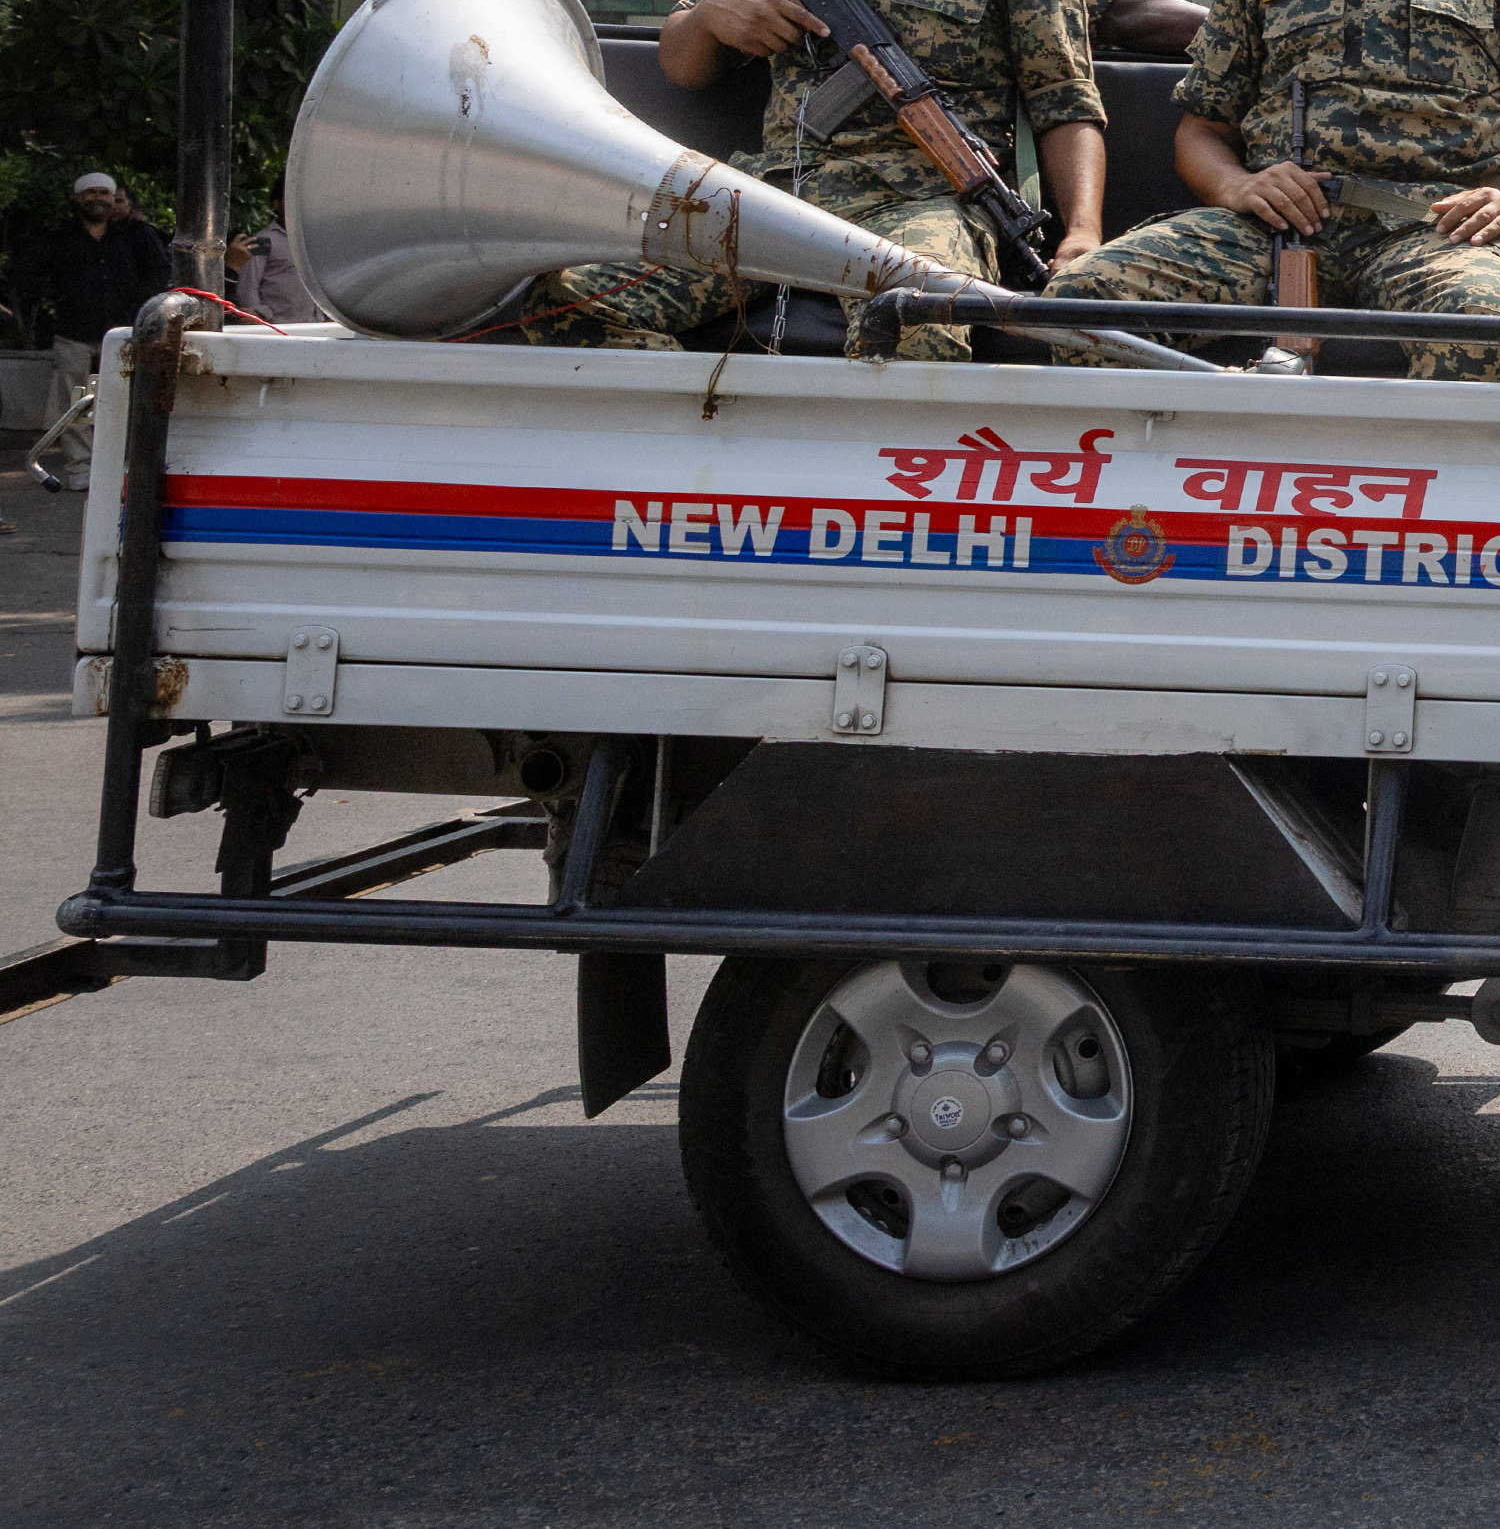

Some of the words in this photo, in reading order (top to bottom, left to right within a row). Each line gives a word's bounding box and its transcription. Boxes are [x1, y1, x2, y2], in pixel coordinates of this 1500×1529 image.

[878, 426, 1115, 504] शौर्य
[1175, 457, 1438, 519] वाहन
[612, 499, 786, 557] NEW
[809, 507, 1033, 569] DELHI
